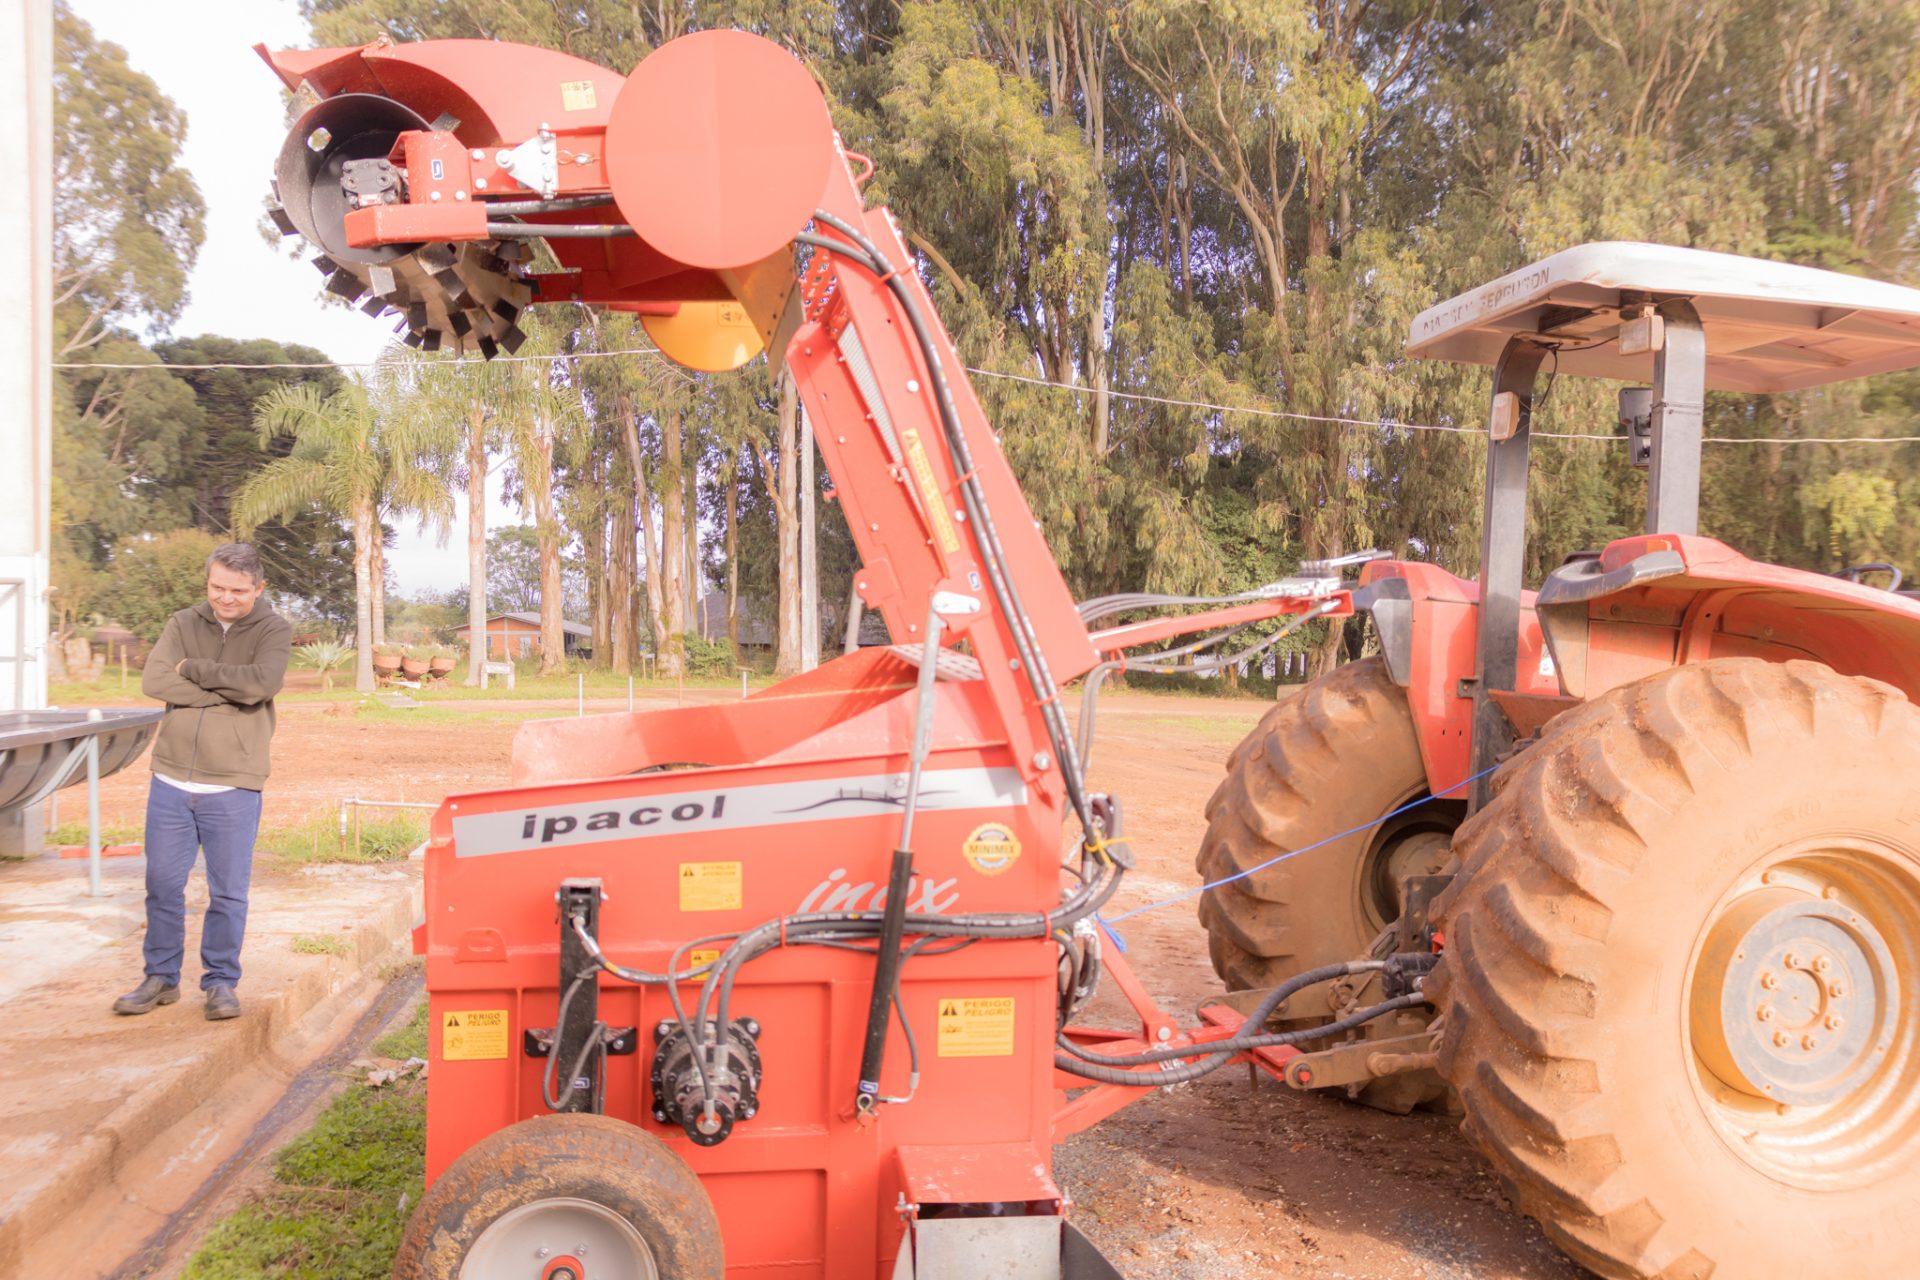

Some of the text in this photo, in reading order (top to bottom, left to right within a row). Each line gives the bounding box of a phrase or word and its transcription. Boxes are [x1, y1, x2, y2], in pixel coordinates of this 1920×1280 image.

[521, 795, 727, 843] ipacol
[969, 844, 1015, 855] MINIMIX
[964, 1000, 1012, 1008] PERIGO
